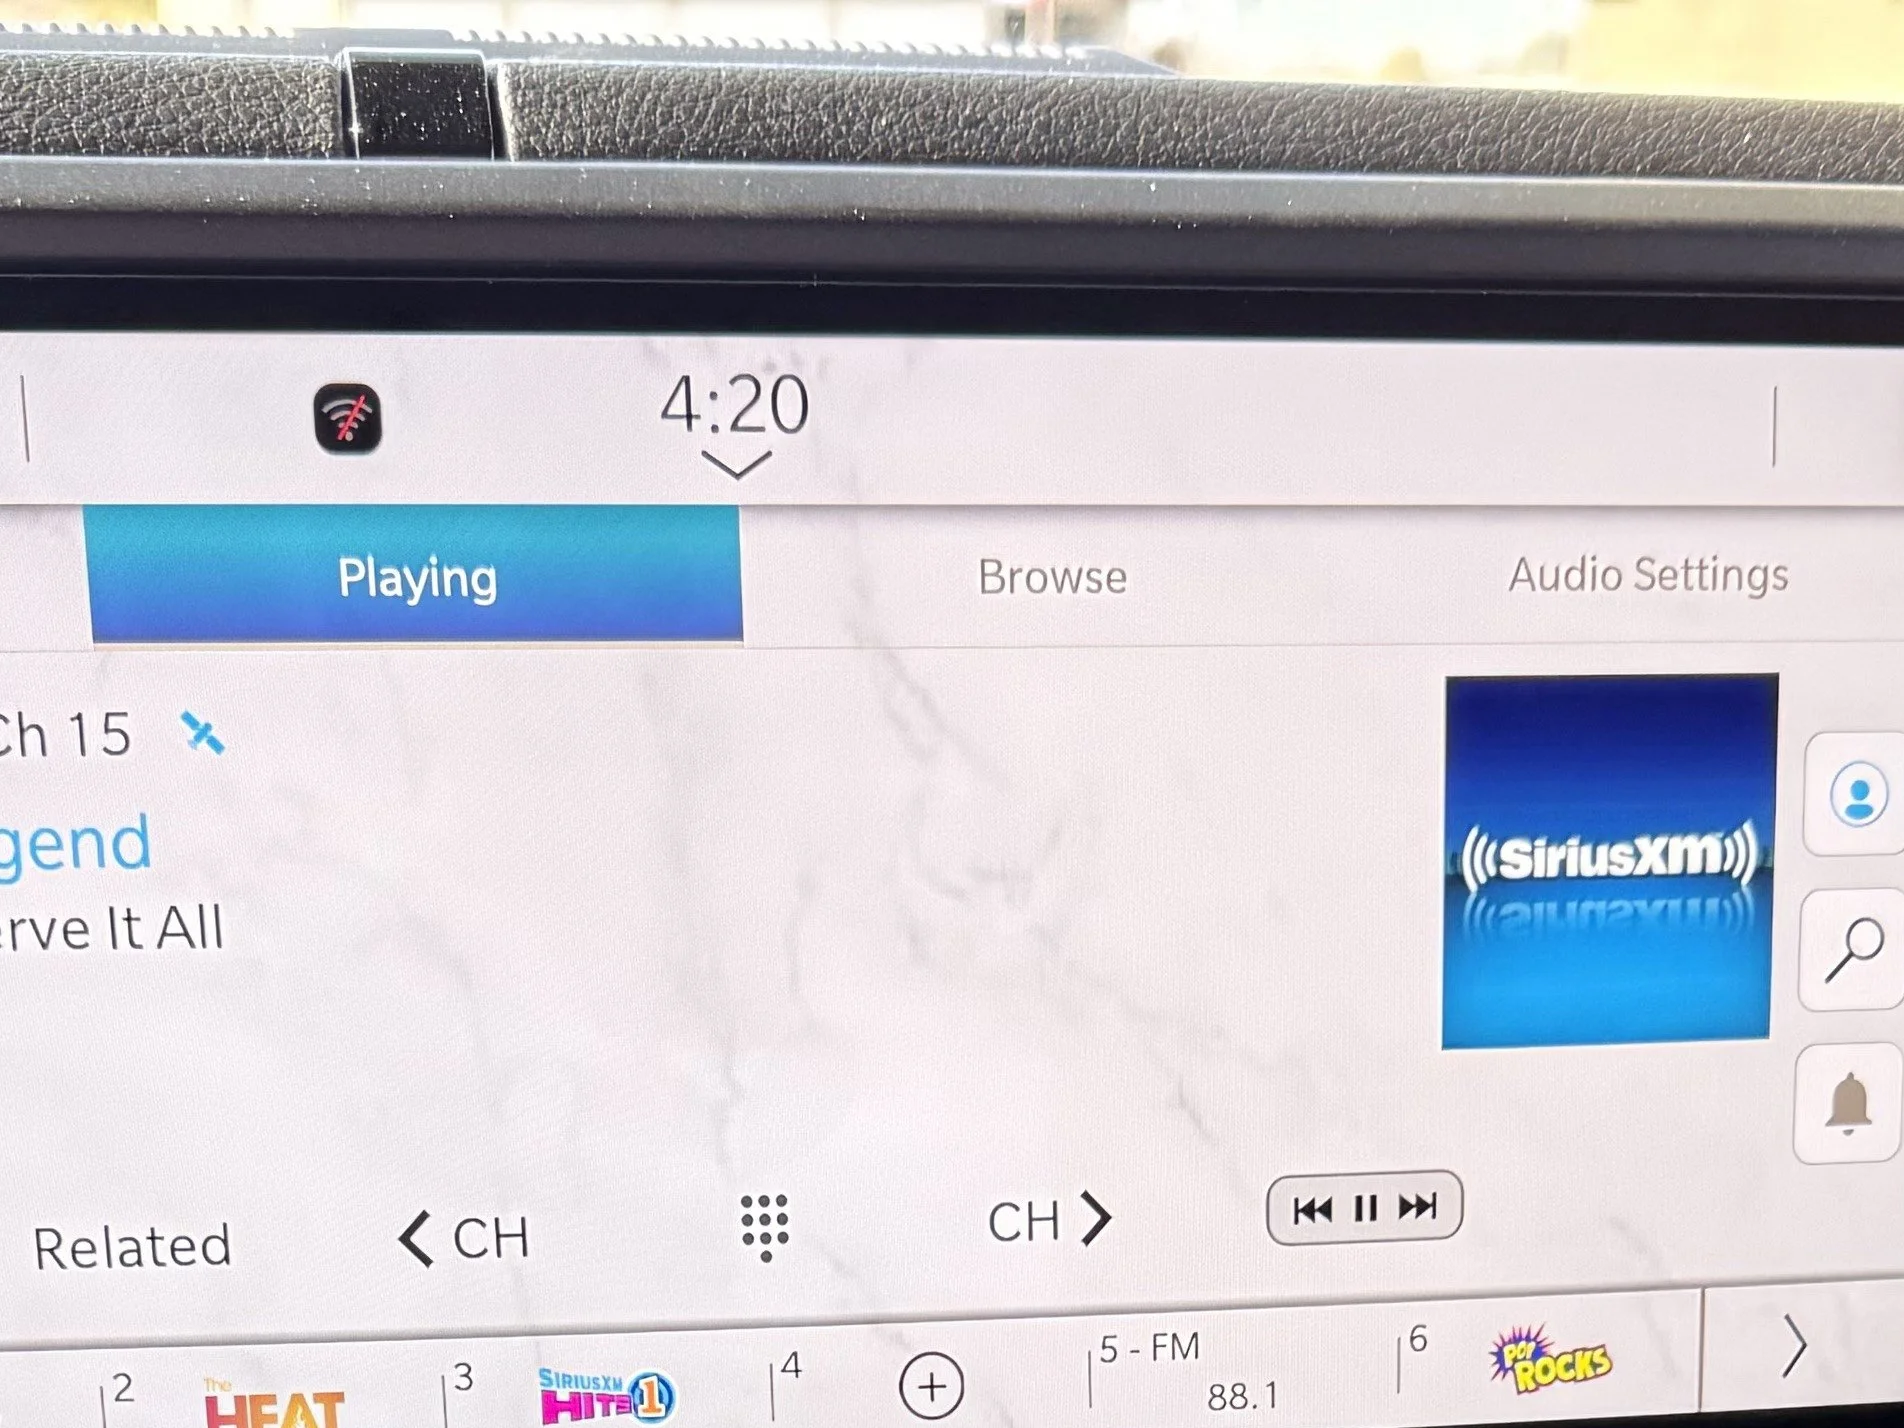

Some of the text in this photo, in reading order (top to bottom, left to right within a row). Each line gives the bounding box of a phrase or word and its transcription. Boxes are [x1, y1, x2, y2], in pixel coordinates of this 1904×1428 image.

[659, 373, 809, 435] 4:20
[338, 555, 499, 605] Playing
[978, 556, 1128, 596] Browse
[1508, 553, 1789, 601] Audio Settings
[73, 710, 132, 758] 15
[108, 905, 144, 951] It
[156, 903, 224, 950] All
[452, 1216, 529, 1261] CH
[987, 1200, 1062, 1242] CH
[34, 1223, 232, 1272] Related
[1099, 1334, 1119, 1363] 5
[1151, 1331, 1201, 1361] FM
[1408, 1324, 1428, 1354] 6
[203, 1375, 232, 1393] The
[454, 1362, 474, 1392] 3
[779, 1351, 802, 1380] 4
[1513, 1344, 1613, 1394] ROCKS
[113, 1375, 133, 1403] 2
[541, 1390, 632, 1425] HITS
[1206, 1381, 1280, 1413] 88.1
